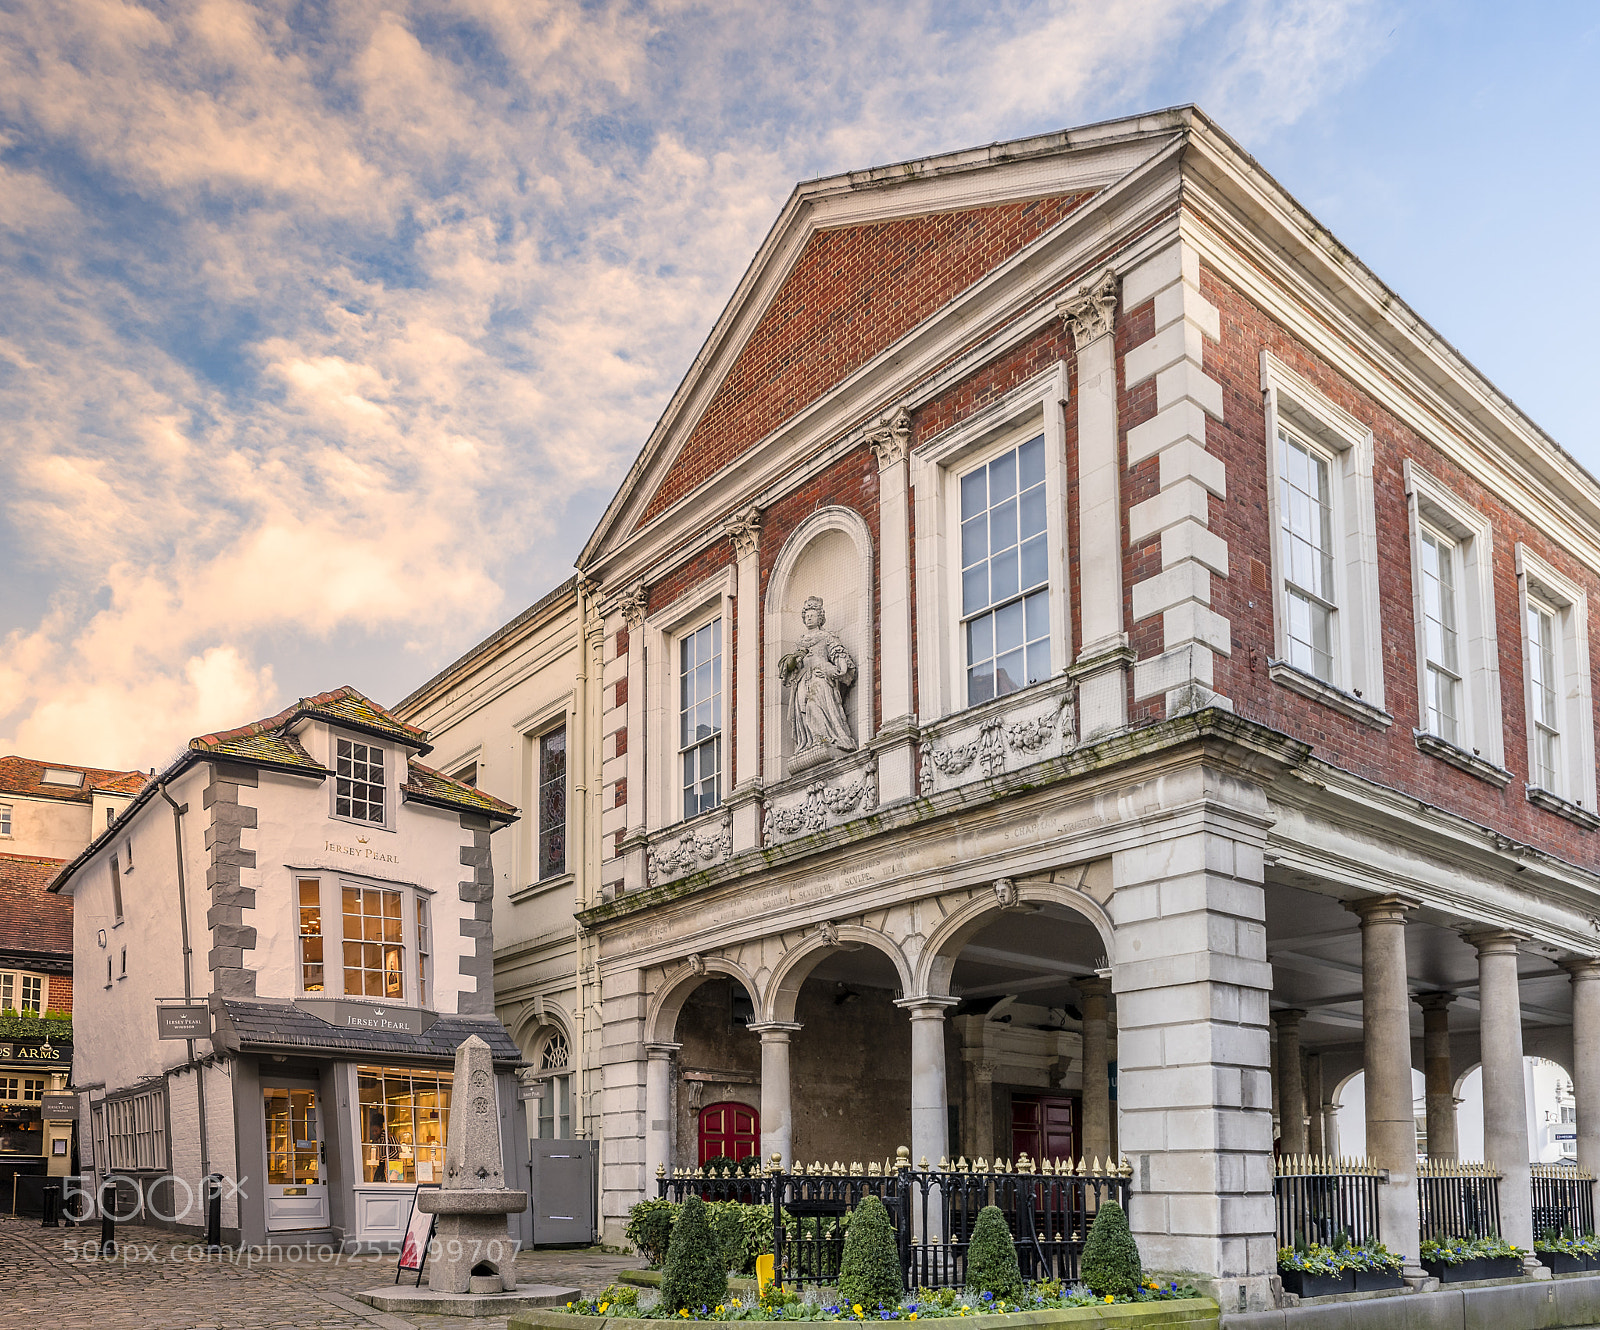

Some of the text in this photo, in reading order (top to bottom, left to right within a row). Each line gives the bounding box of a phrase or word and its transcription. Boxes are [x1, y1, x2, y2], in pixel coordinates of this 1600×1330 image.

[324, 840, 399, 864] JERSEY PEARL
[347, 1015, 410, 1030] JERSEY PEARL
[17, 1047, 60, 1060] ARMS
